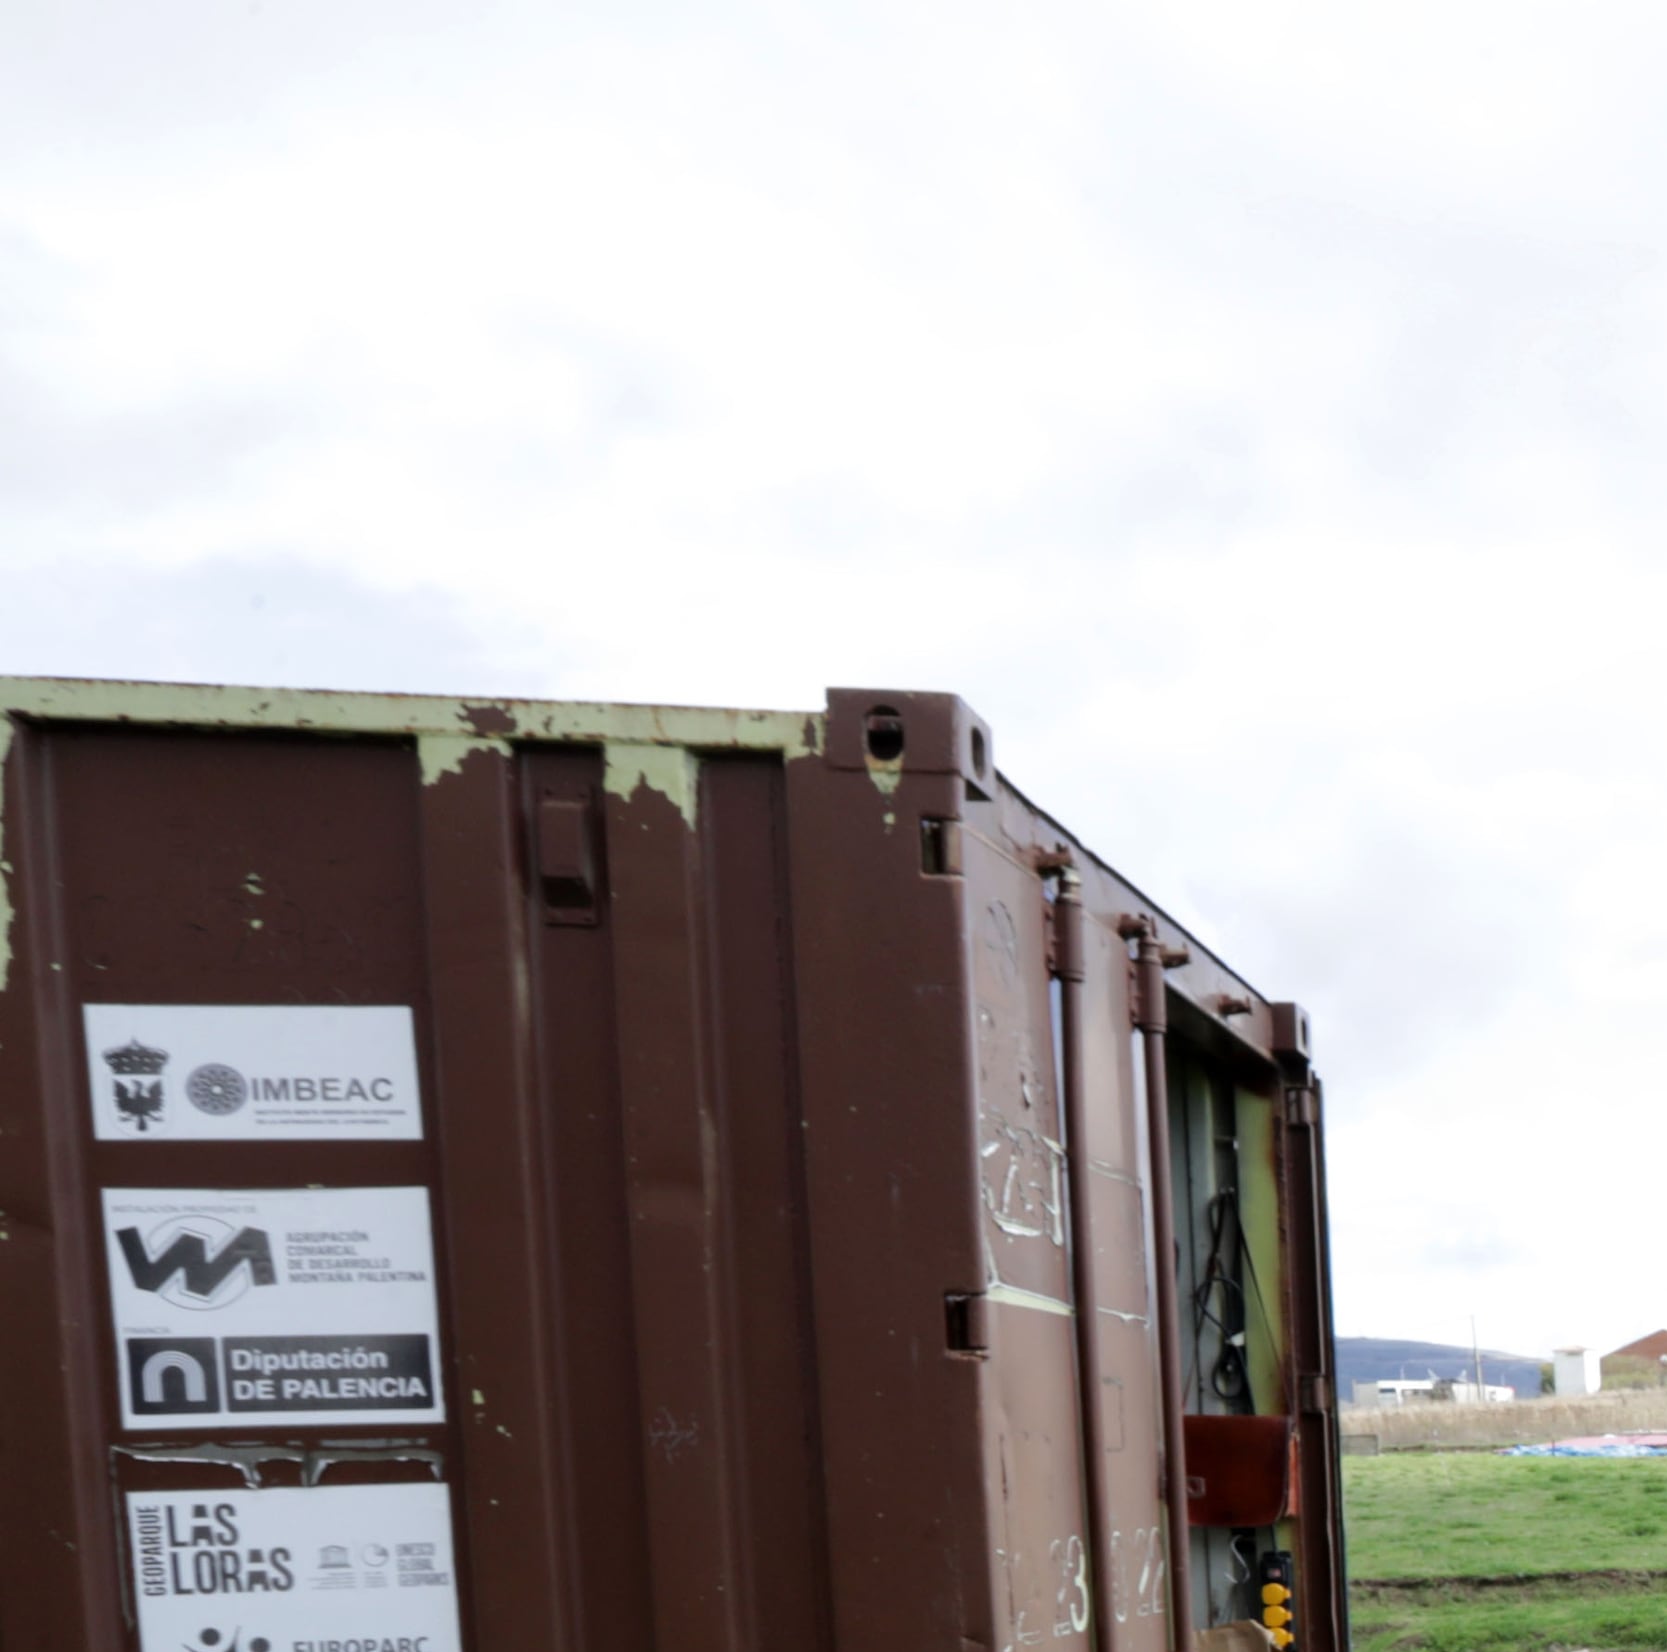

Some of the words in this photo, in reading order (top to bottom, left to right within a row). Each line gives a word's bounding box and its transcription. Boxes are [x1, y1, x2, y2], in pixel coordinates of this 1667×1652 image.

[252, 1077, 394, 1101] IMBEAC
[286, 1245, 358, 1256] COMARCAL
[287, 1258, 303, 1270] DE
[308, 1258, 390, 1269] DESARROLLO
[357, 1270, 427, 1282] PALENTINA
[231, 1347, 388, 1375] Diputación
[233, 1379, 276, 1400] DE
[282, 1375, 428, 1399] PALENCIA
[166, 1503, 239, 1547] LAS
[136, 1506, 167, 1597] GEOPARQUE
[170, 1547, 294, 1595] LORAS
